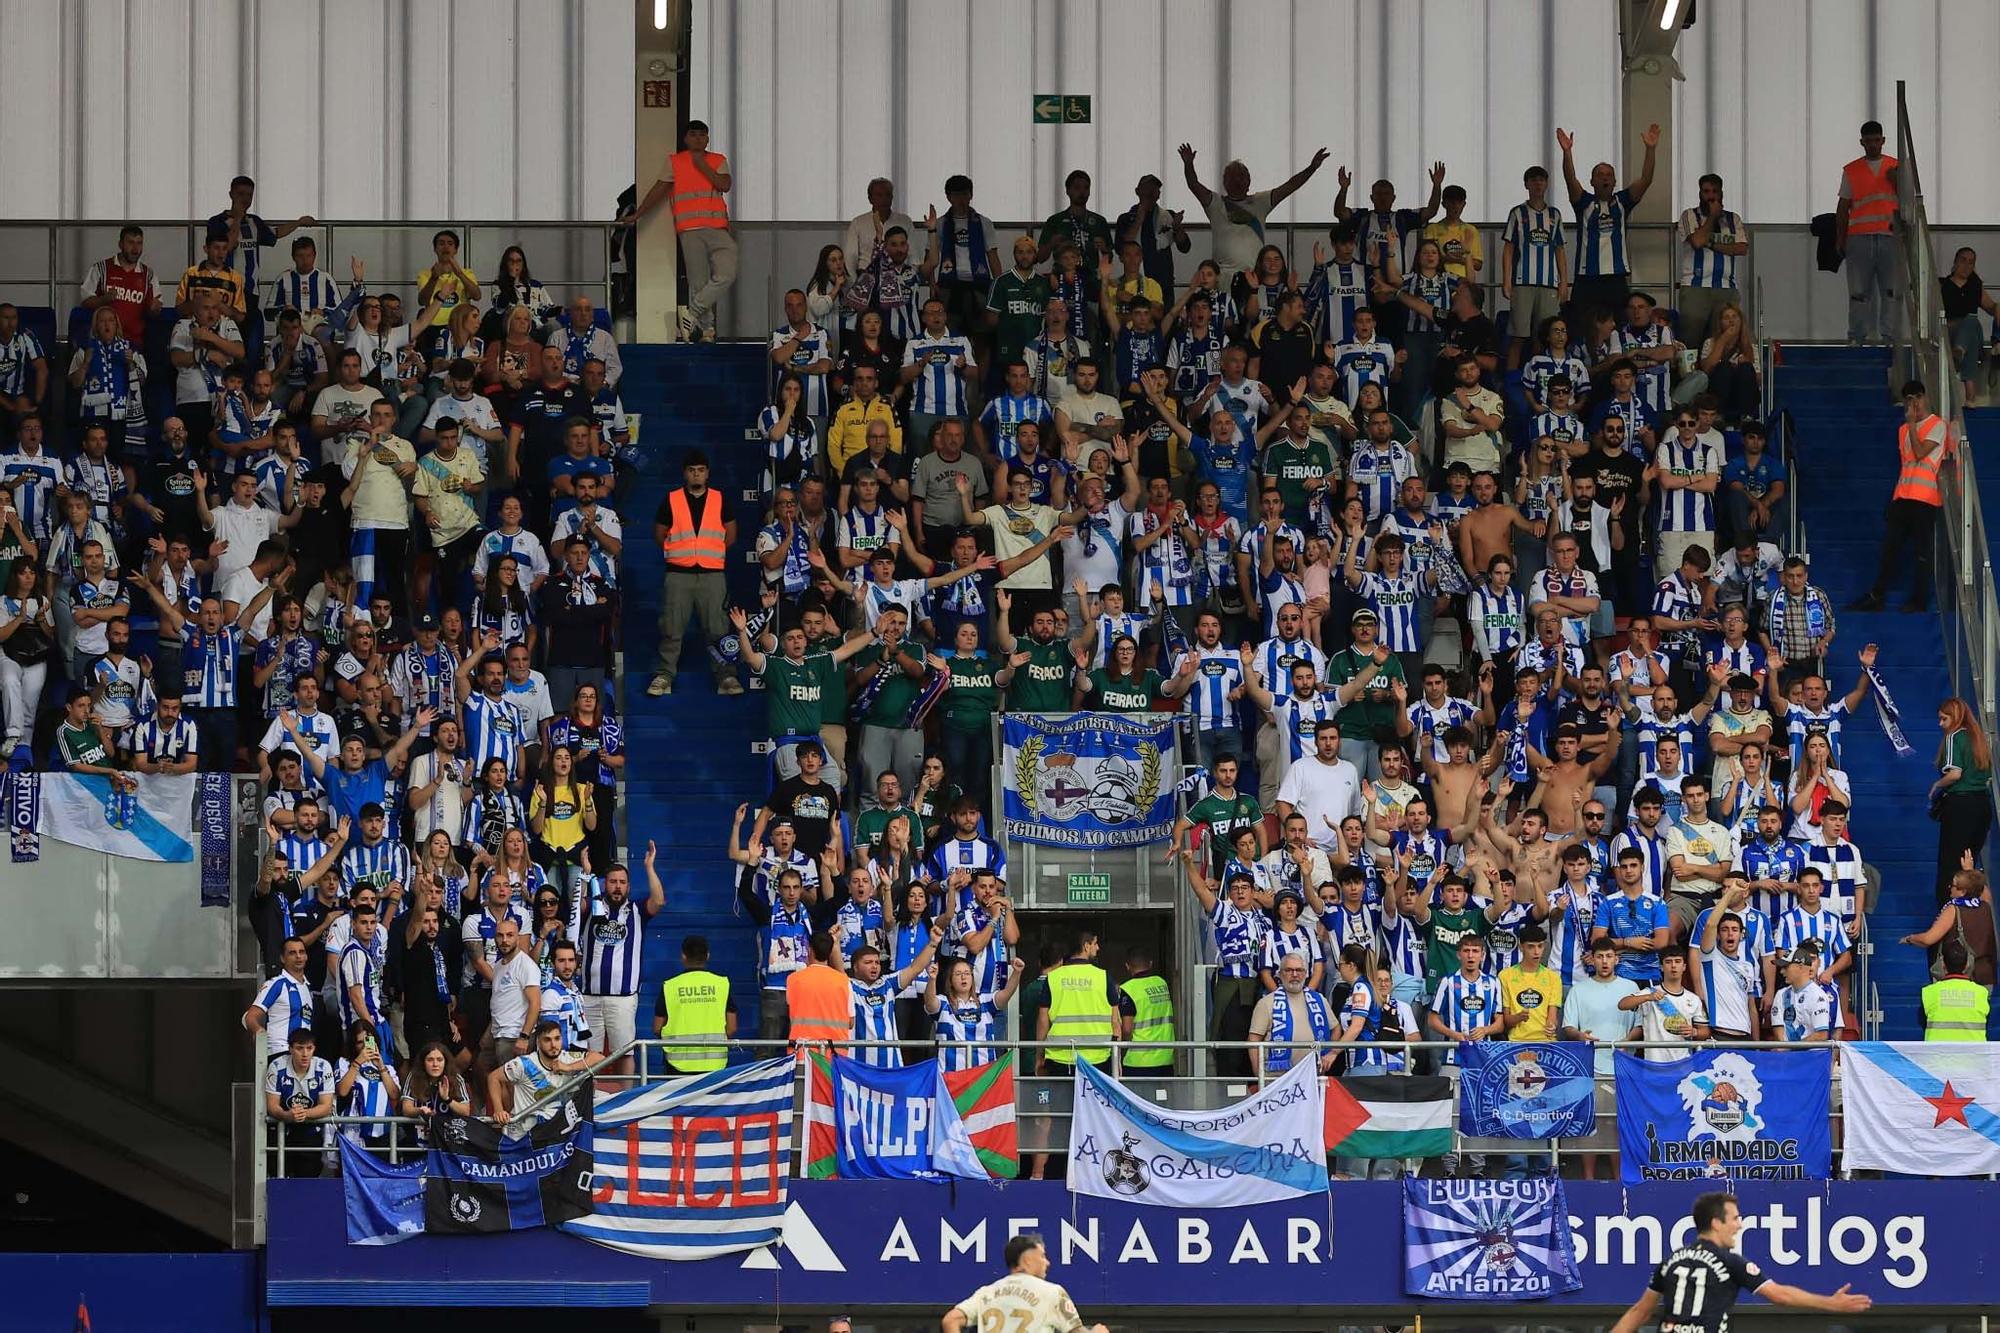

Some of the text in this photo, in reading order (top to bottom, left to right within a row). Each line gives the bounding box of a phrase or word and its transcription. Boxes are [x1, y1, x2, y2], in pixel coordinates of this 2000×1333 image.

[106, 285, 144, 304] FIRACO
[1336, 287, 1365, 295] FADESA
[850, 419, 870, 427] ABAN
[1282, 465, 1323, 478] FEIRACO
[854, 536, 884, 549] FERACO
[1375, 592, 1414, 605] FEIRACO
[108, 684, 132, 692] Estrella
[951, 674, 992, 688] FEIRACO
[1103, 691, 1147, 708] FEIRACO
[1081, 829, 1105, 846] AO
[1072, 875, 1107, 886] SALIDA
[1072, 890, 1107, 901] IRTEERA
[1061, 977, 1093, 987] EULEN
[677, 985, 716, 997] EULEN
[1488, 1057, 1511, 1086] CLUB
[1482, 1085, 1495, 1113] REAL
[1074, 1134, 1100, 1165] A
[461, 1141, 576, 1178] CAMANDULAS
[1640, 1164, 1805, 1180] BRANUIAZUL
[993, 1284, 1041, 1307] NAVARRO
[1672, 1265, 1708, 1317] 11
